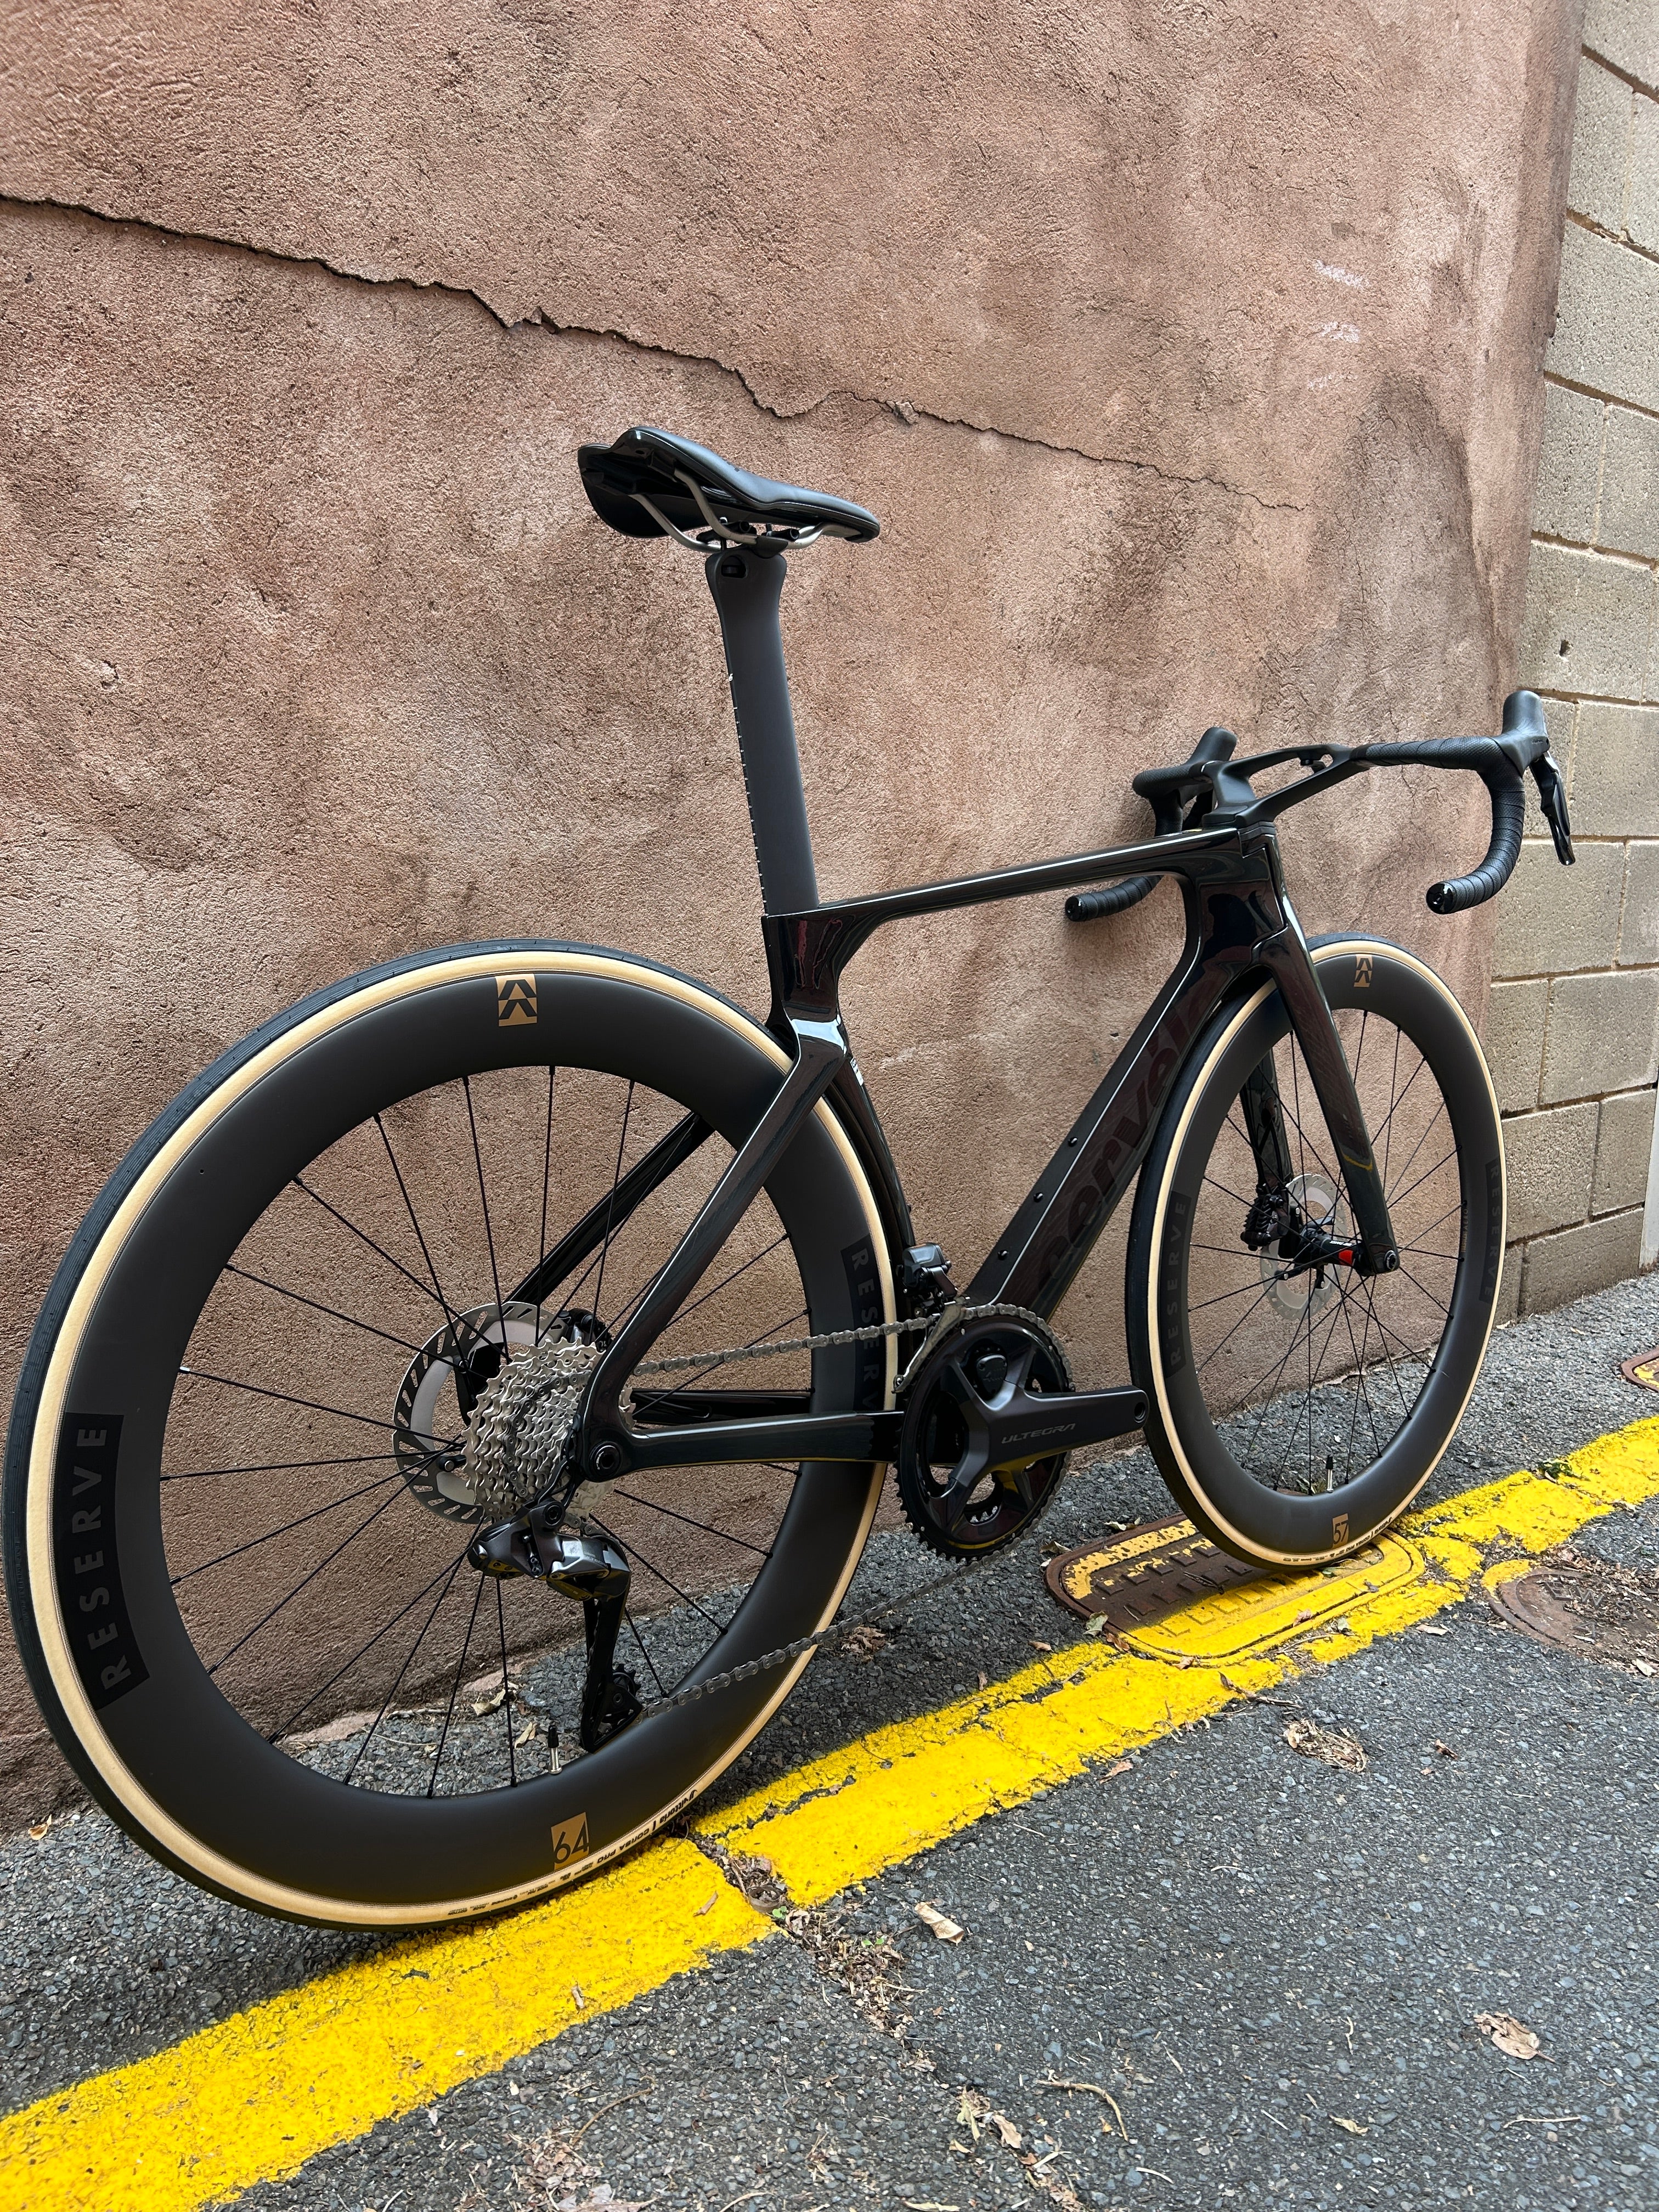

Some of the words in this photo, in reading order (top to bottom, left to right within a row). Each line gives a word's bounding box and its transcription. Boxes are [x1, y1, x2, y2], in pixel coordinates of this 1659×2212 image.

[1485, 1167, 1502, 1296] RESERVE
[1167, 1201, 1186, 1366] RESERVE
[1002, 1423, 1076, 1444] ULTEGRA
[1333, 1519, 1348, 1545] 57
[72, 1428, 132, 1690] RESERVE
[659, 1796, 689, 1824] vittoria
[553, 1820, 590, 1864] 64
[619, 1827, 650, 1851] CORSA
[597, 1849, 616, 1864] PRO
